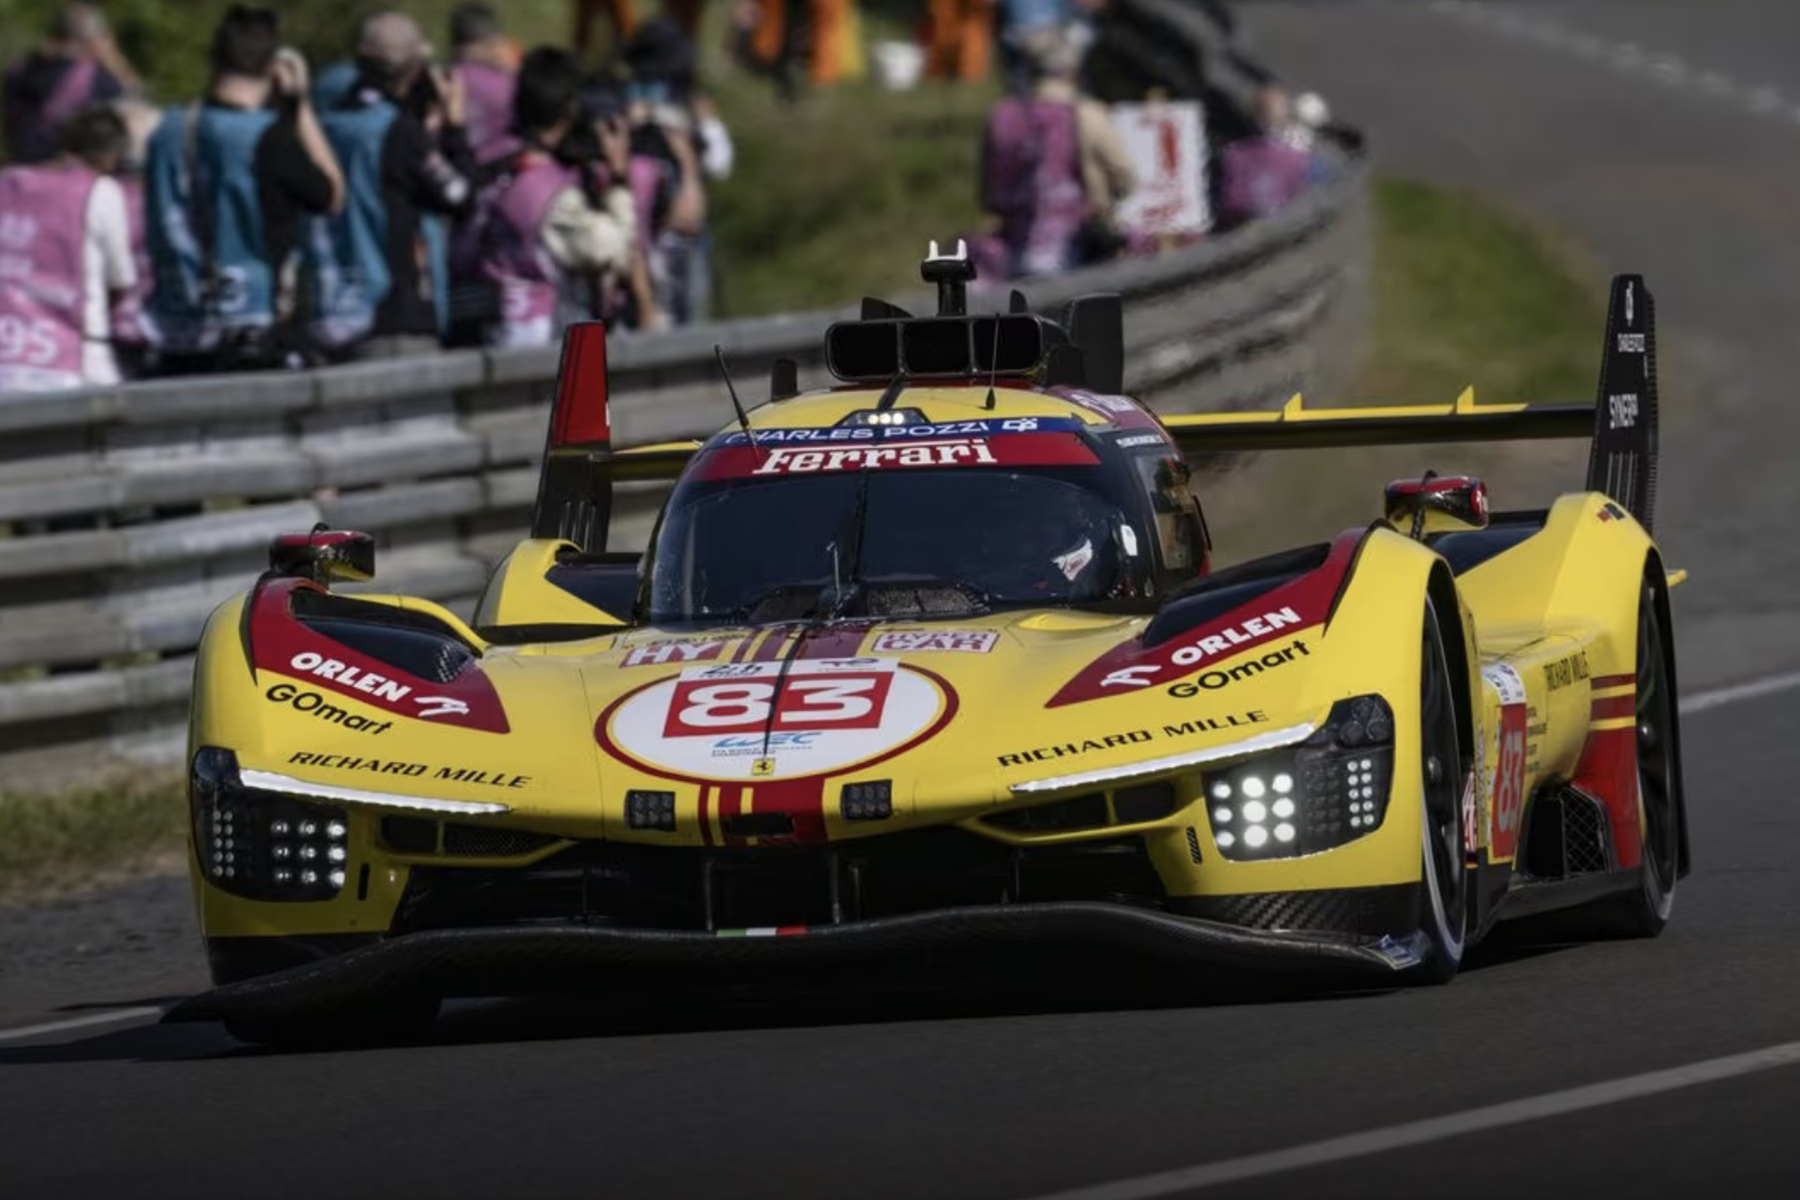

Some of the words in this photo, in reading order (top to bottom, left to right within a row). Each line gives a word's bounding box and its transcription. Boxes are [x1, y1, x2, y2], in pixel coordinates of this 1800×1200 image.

[725, 428, 874, 444] CHARLES
[884, 422, 990, 438] POZZI
[752, 439, 997, 474] Ferrari
[883, 639, 983, 650] CAR
[1172, 607, 1302, 666] ORLEN
[291, 652, 412, 703] ORLEN
[1168, 640, 1310, 698] GOmart
[266, 683, 393, 735] GOmart
[679, 677, 876, 727] 83
[998, 729, 1153, 767] RICHARD
[1163, 711, 1269, 737] MILLE
[288, 752, 427, 776] RICHARD
[434, 767, 533, 789] MILLE
